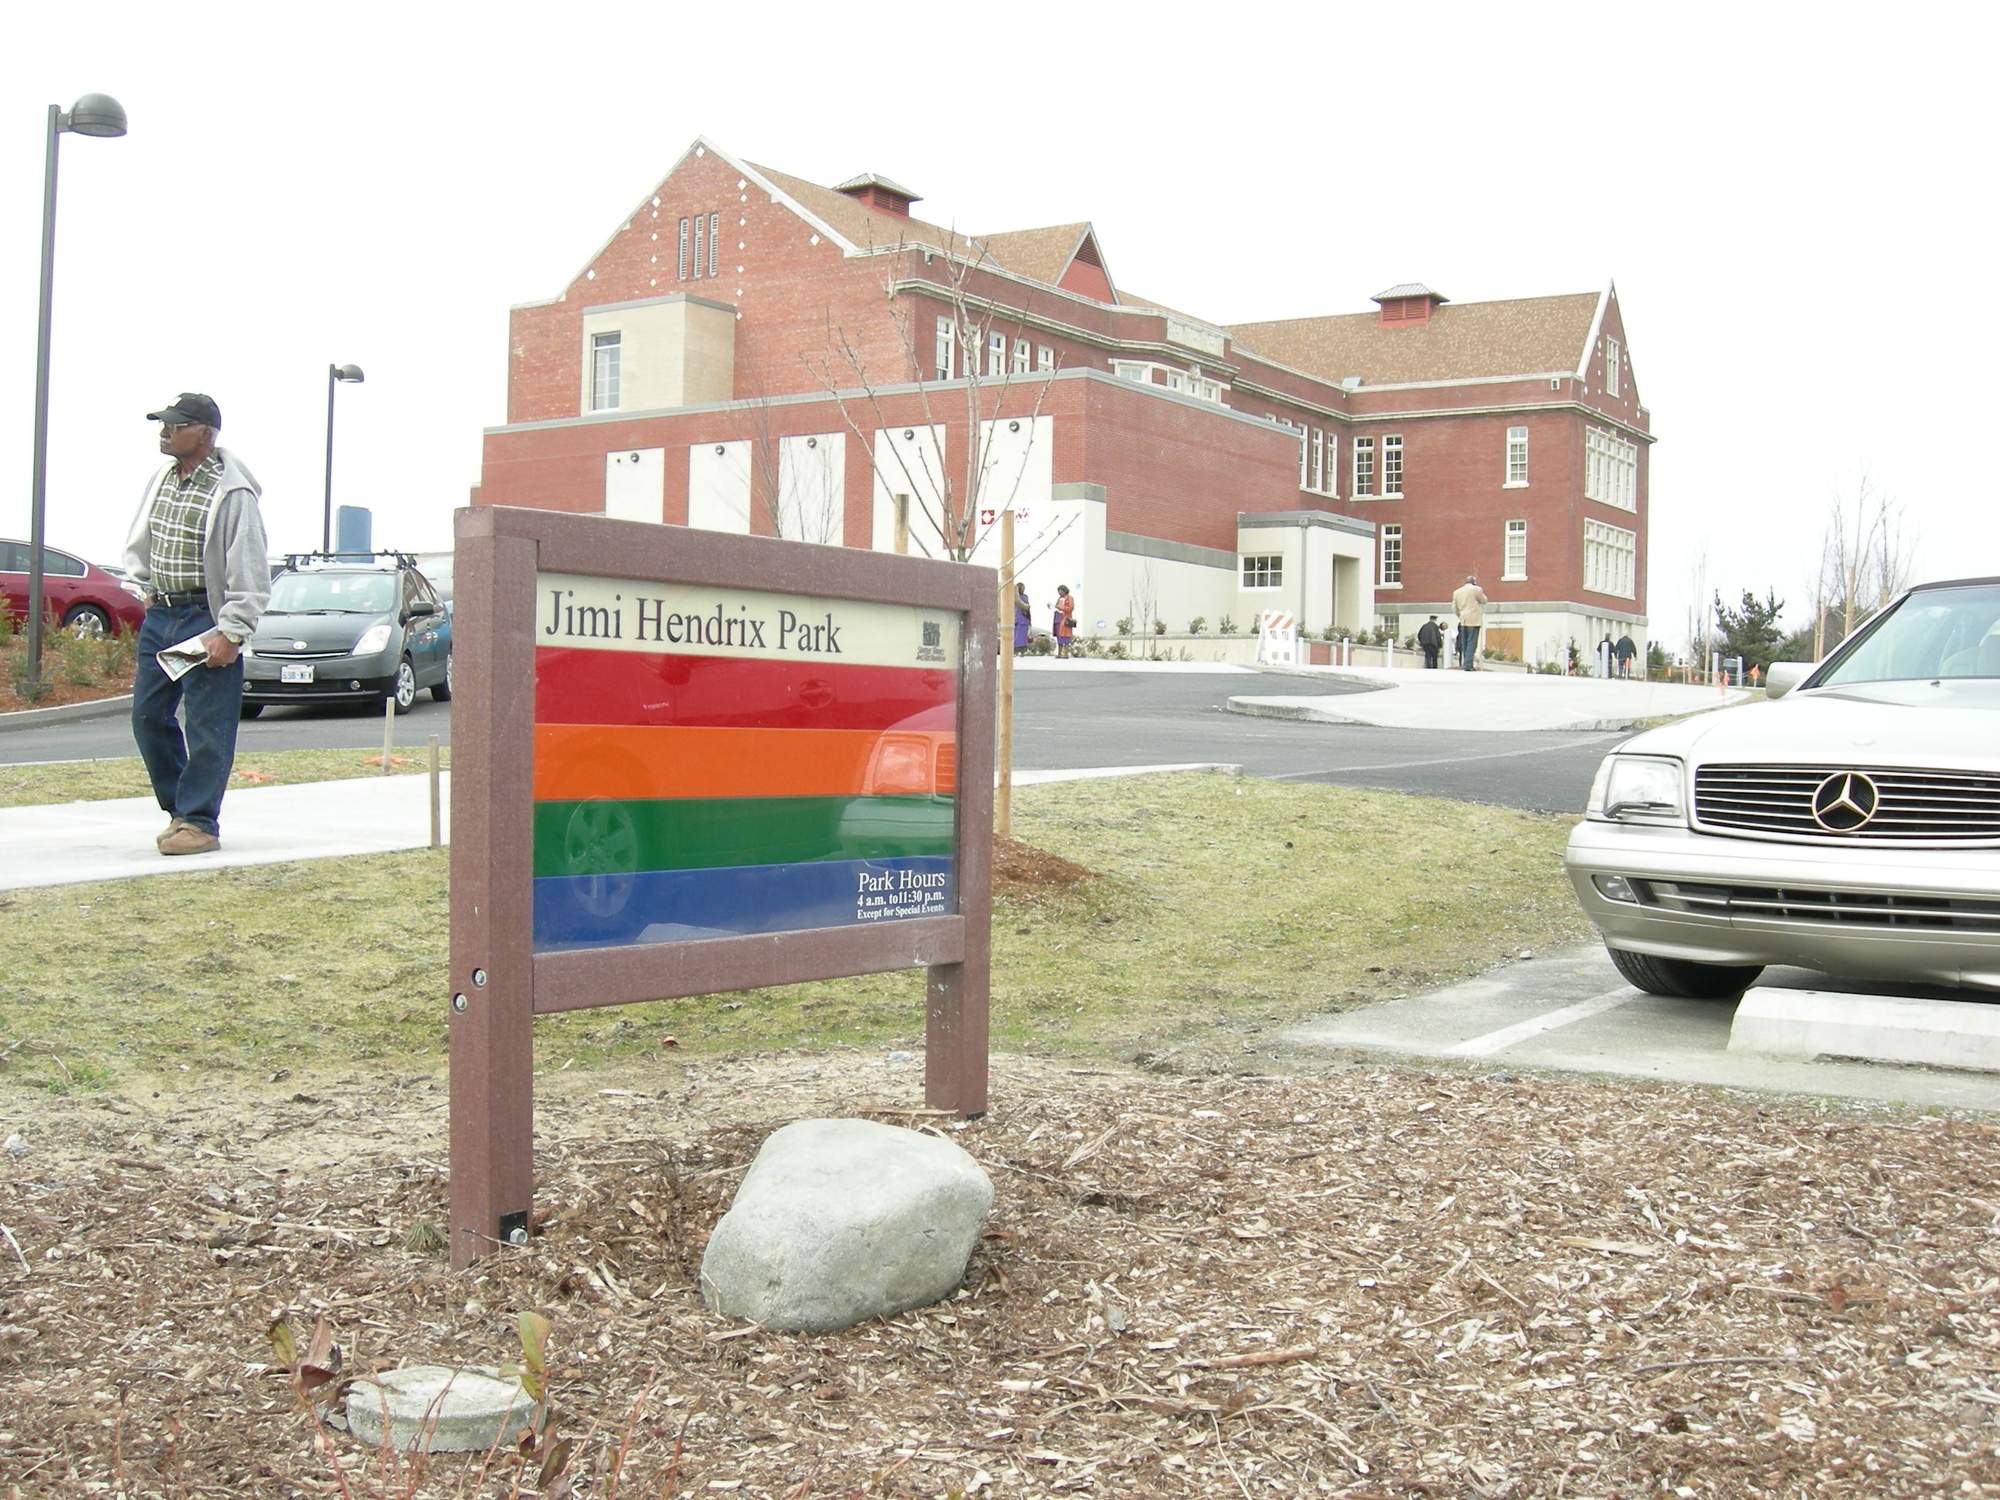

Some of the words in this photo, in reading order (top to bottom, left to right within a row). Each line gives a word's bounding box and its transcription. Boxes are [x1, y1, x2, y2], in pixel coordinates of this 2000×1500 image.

[545, 590, 622, 638] Jimi
[635, 597, 766, 648] Hendrix
[778, 610, 842, 653] Park
[858, 870, 894, 892] Park
[899, 870, 945, 889] Hours
[857, 895, 863, 906] 4
[866, 895, 886, 906] a.m.
[925, 892, 944, 905] p.m.
[857, 909, 882, 920] Except
[883, 906, 894, 917] for
[895, 905, 921, 918] Special
[922, 904, 944, 913] Events
